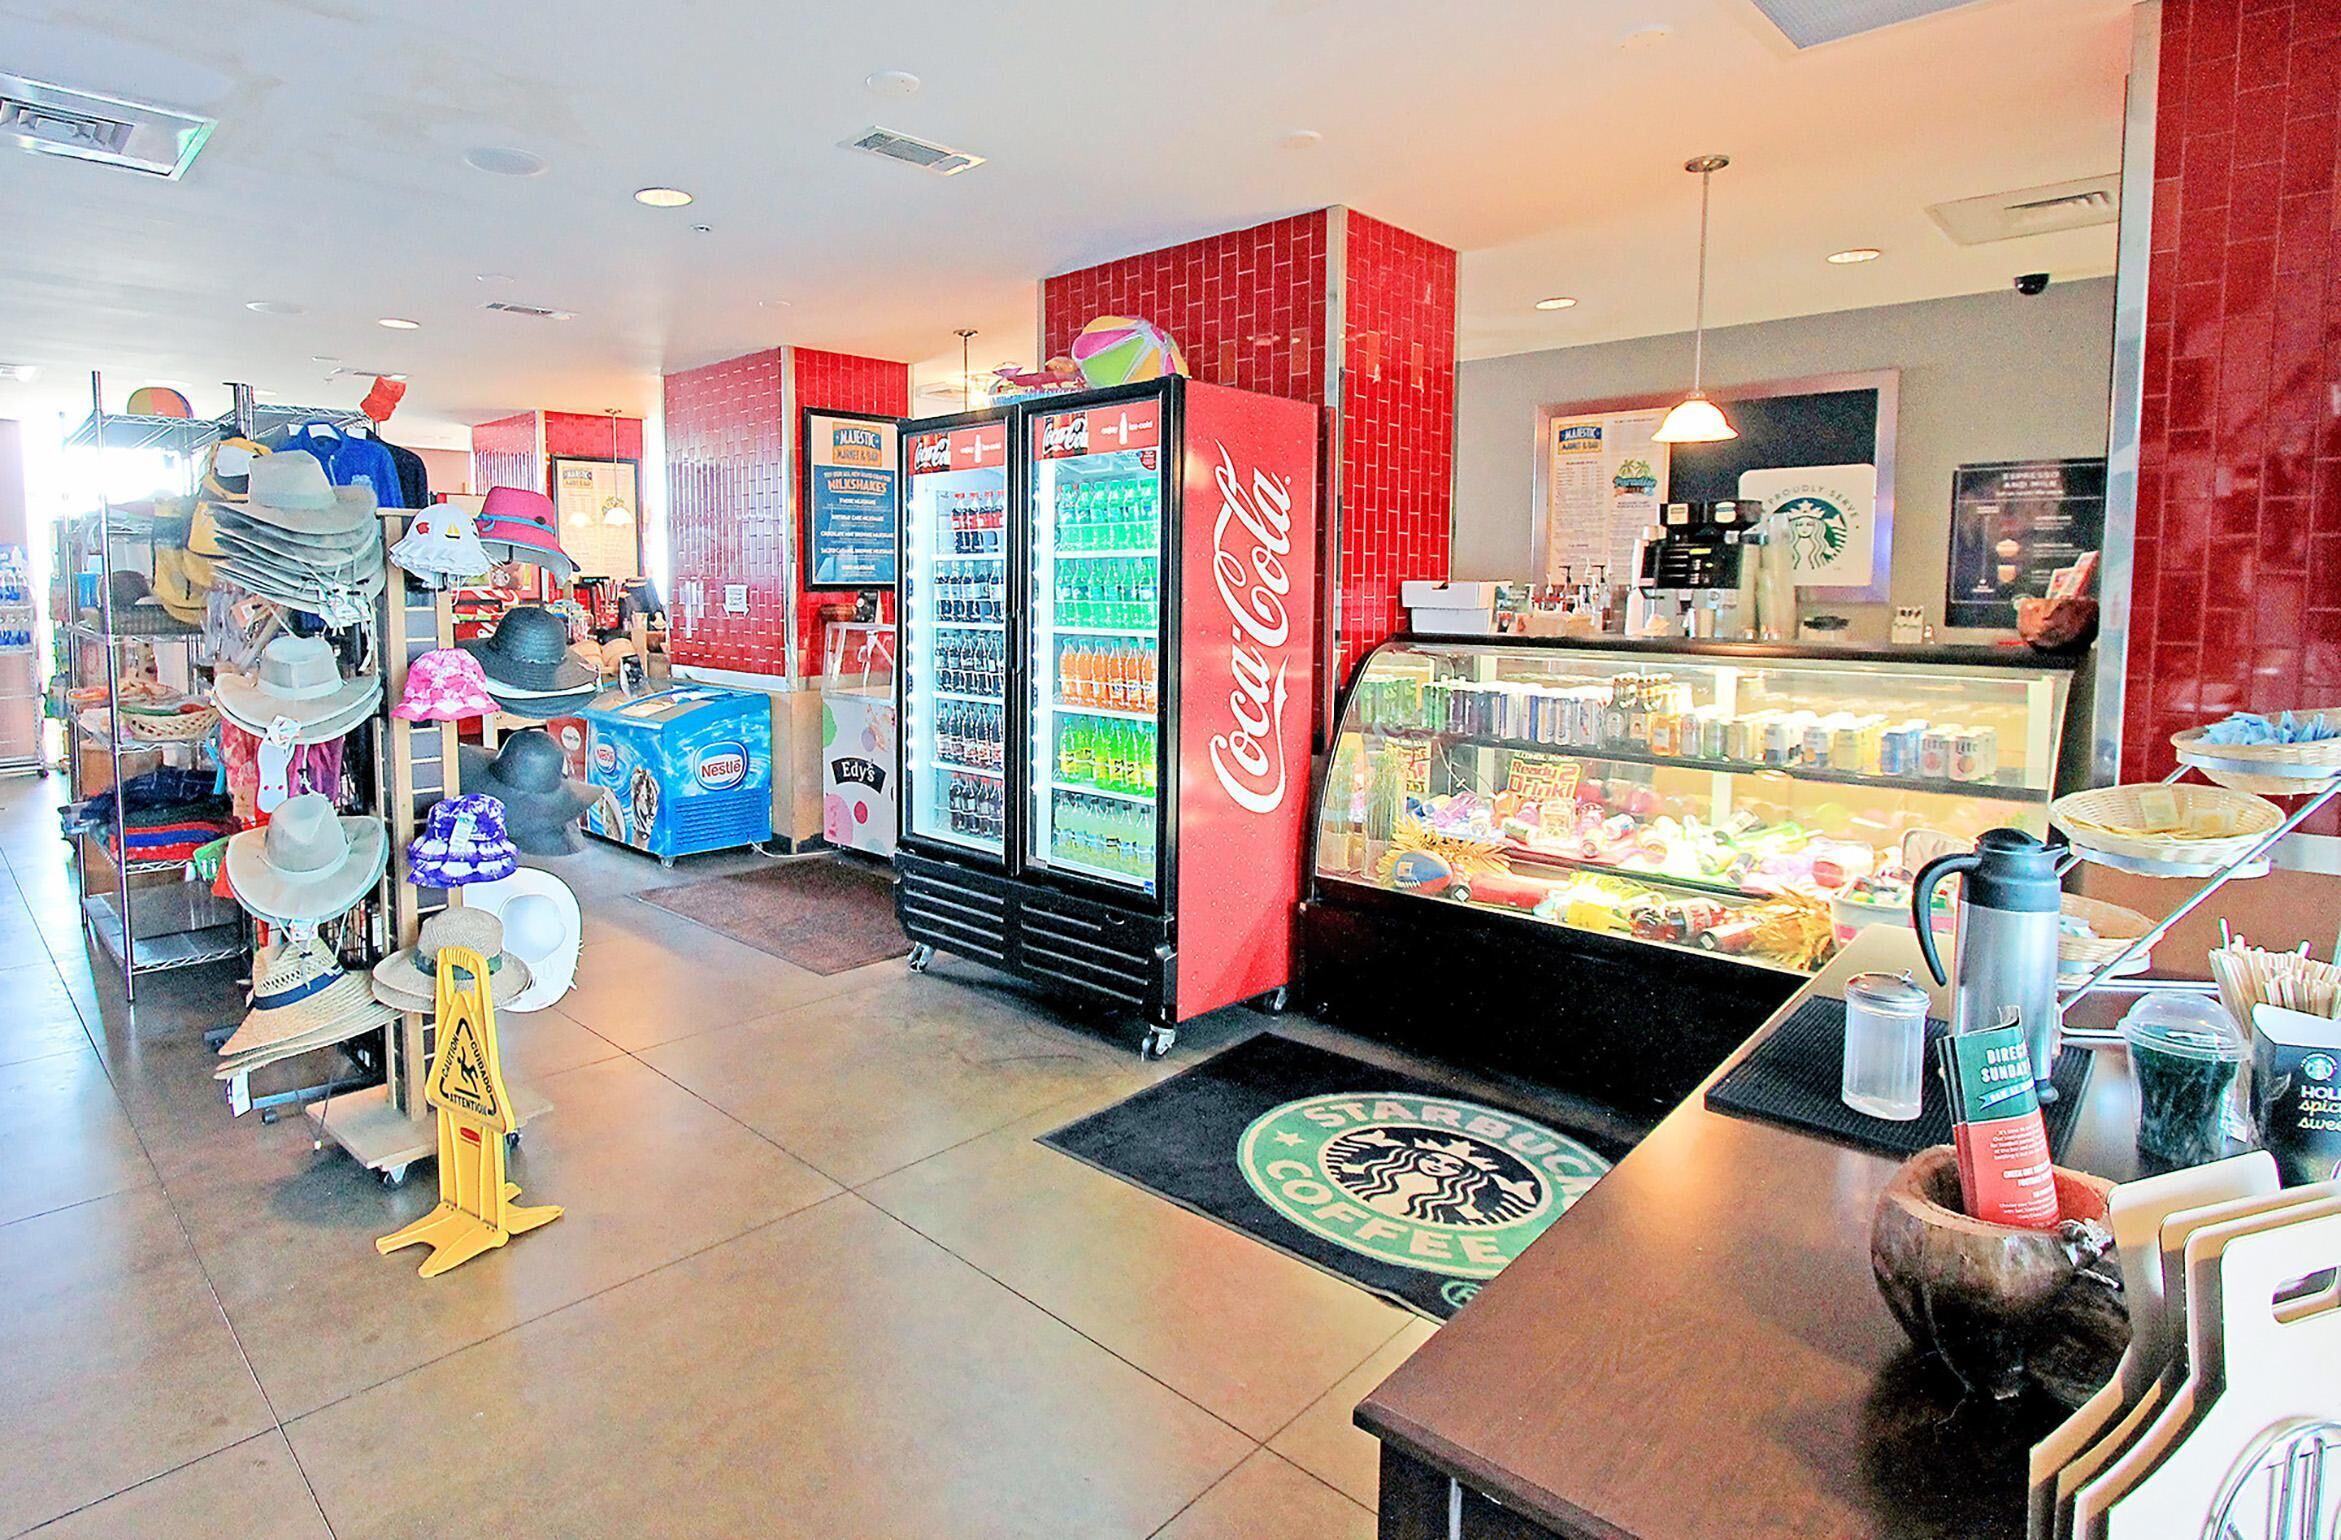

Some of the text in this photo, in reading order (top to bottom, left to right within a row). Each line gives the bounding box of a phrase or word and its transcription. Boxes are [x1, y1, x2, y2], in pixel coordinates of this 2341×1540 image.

[840, 429, 876, 448] MAJESTIC
[827, 478, 888, 494] MILKSHAKES
[1768, 484, 1860, 517] PROUDLY SERVE
[1208, 438, 1293, 815] Coca-Cola
[841, 761, 876, 782] Edy's
[1511, 760, 1578, 782] Ready 2
[441, 1034, 460, 1078] CAUTION
[470, 1041, 493, 1094] CUIDADO
[1980, 1057, 2033, 1083] SUNDAY
[448, 1093, 488, 1117] ATTENTION
[2297, 1100, 2341, 1117] spic
[1266, 1159, 1513, 1264] COFFEE
